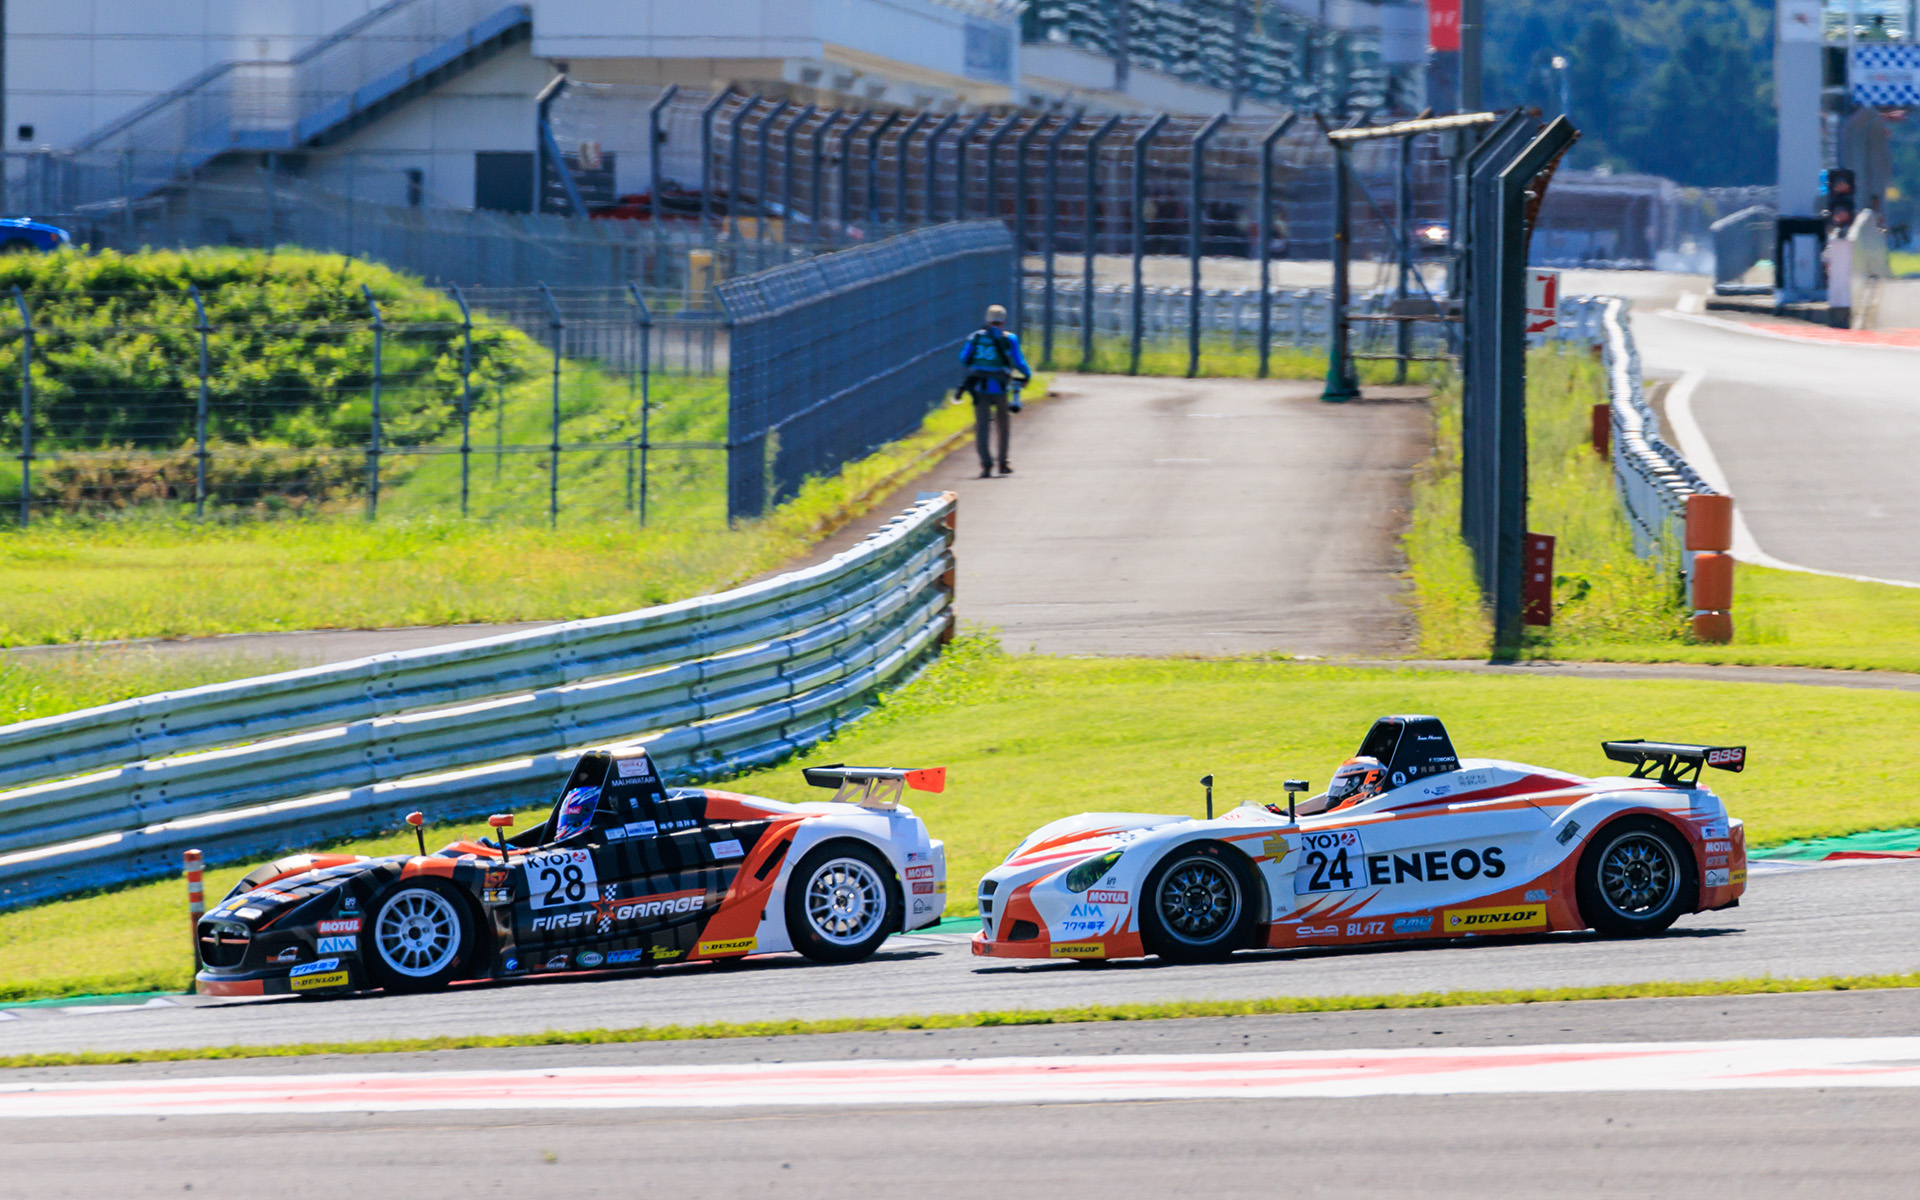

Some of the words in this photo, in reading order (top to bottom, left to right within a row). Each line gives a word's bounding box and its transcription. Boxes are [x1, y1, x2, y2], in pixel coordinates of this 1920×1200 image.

[1708, 749, 1743, 764] BBS
[1705, 841, 1732, 852] MOTUL
[1306, 847, 1353, 891] 24
[1368, 846, 1506, 886] ENEOS
[540, 864, 586, 906] 28
[1088, 891, 1127, 903] MOTUL
[531, 910, 597, 932] FIRST
[616, 895, 705, 920] GARAGE
[1464, 909, 1537, 925] DUNLOP
[320, 920, 360, 932] MOTUL
[711, 941, 752, 950] DUNLOP
[301, 975, 343, 986] DUNLOP
